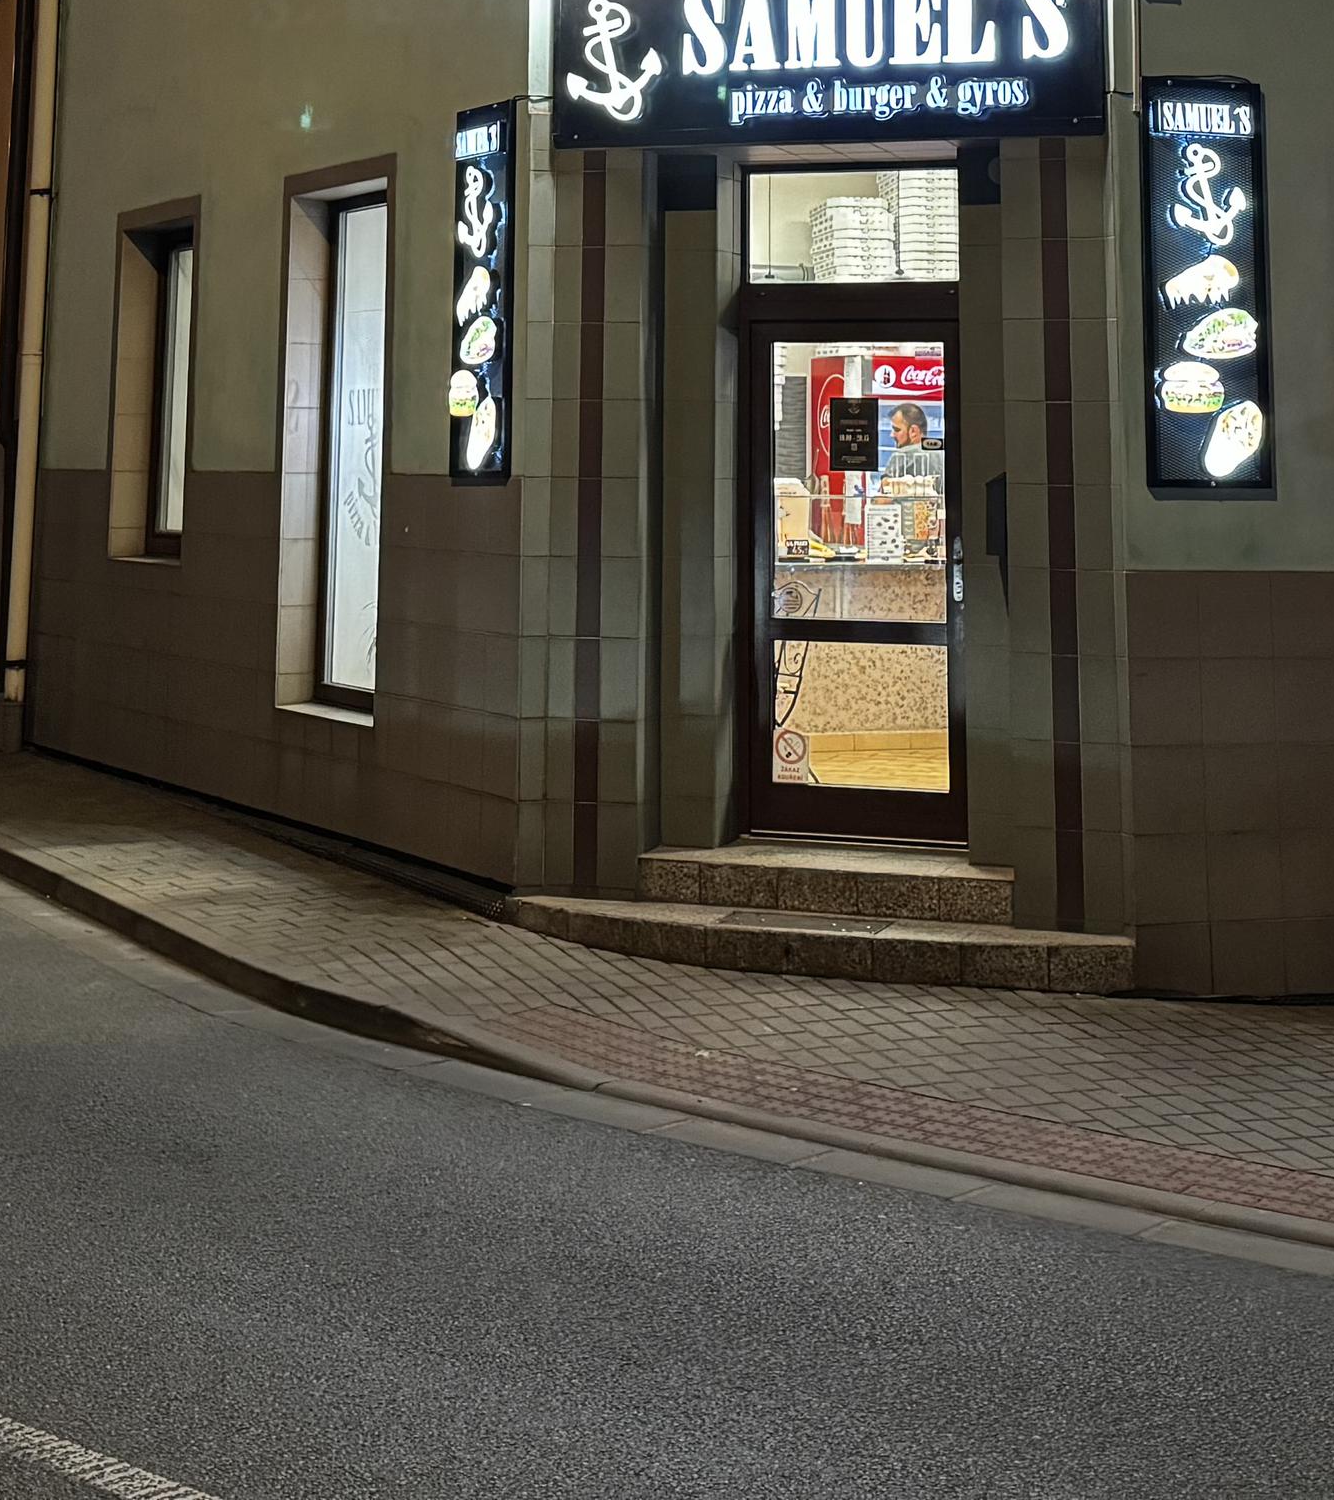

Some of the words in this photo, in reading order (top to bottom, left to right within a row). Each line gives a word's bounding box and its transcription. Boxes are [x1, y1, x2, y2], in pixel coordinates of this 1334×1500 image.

[730, 85, 795, 123] pizza
[802, 78, 826, 114] &
[833, 77, 917, 119] burger
[925, 75, 948, 109] &
[957, 79, 1026, 116] gyros
